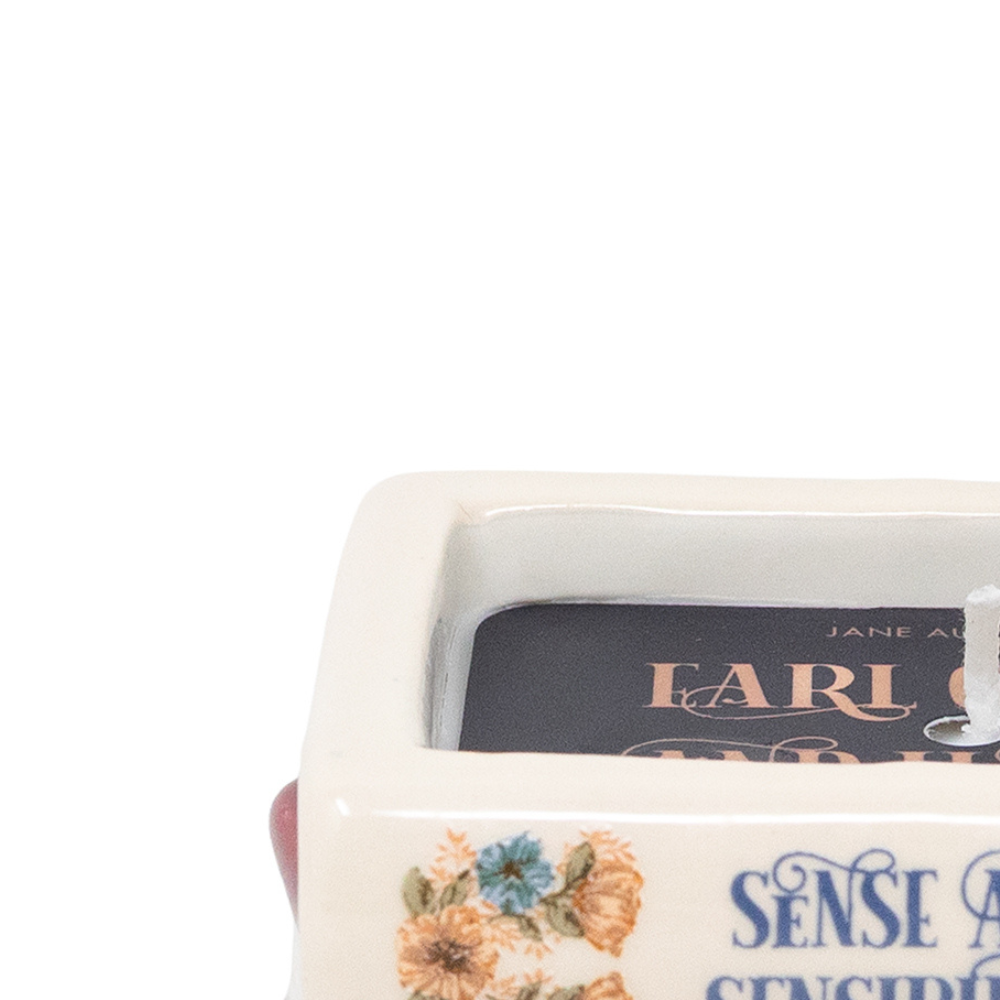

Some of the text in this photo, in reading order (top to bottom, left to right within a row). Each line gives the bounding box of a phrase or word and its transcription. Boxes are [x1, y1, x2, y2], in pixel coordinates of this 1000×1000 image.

[826, 626, 912, 638] JANE
[644, 661, 916, 722] EARL
[730, 848, 939, 949] SENSE
